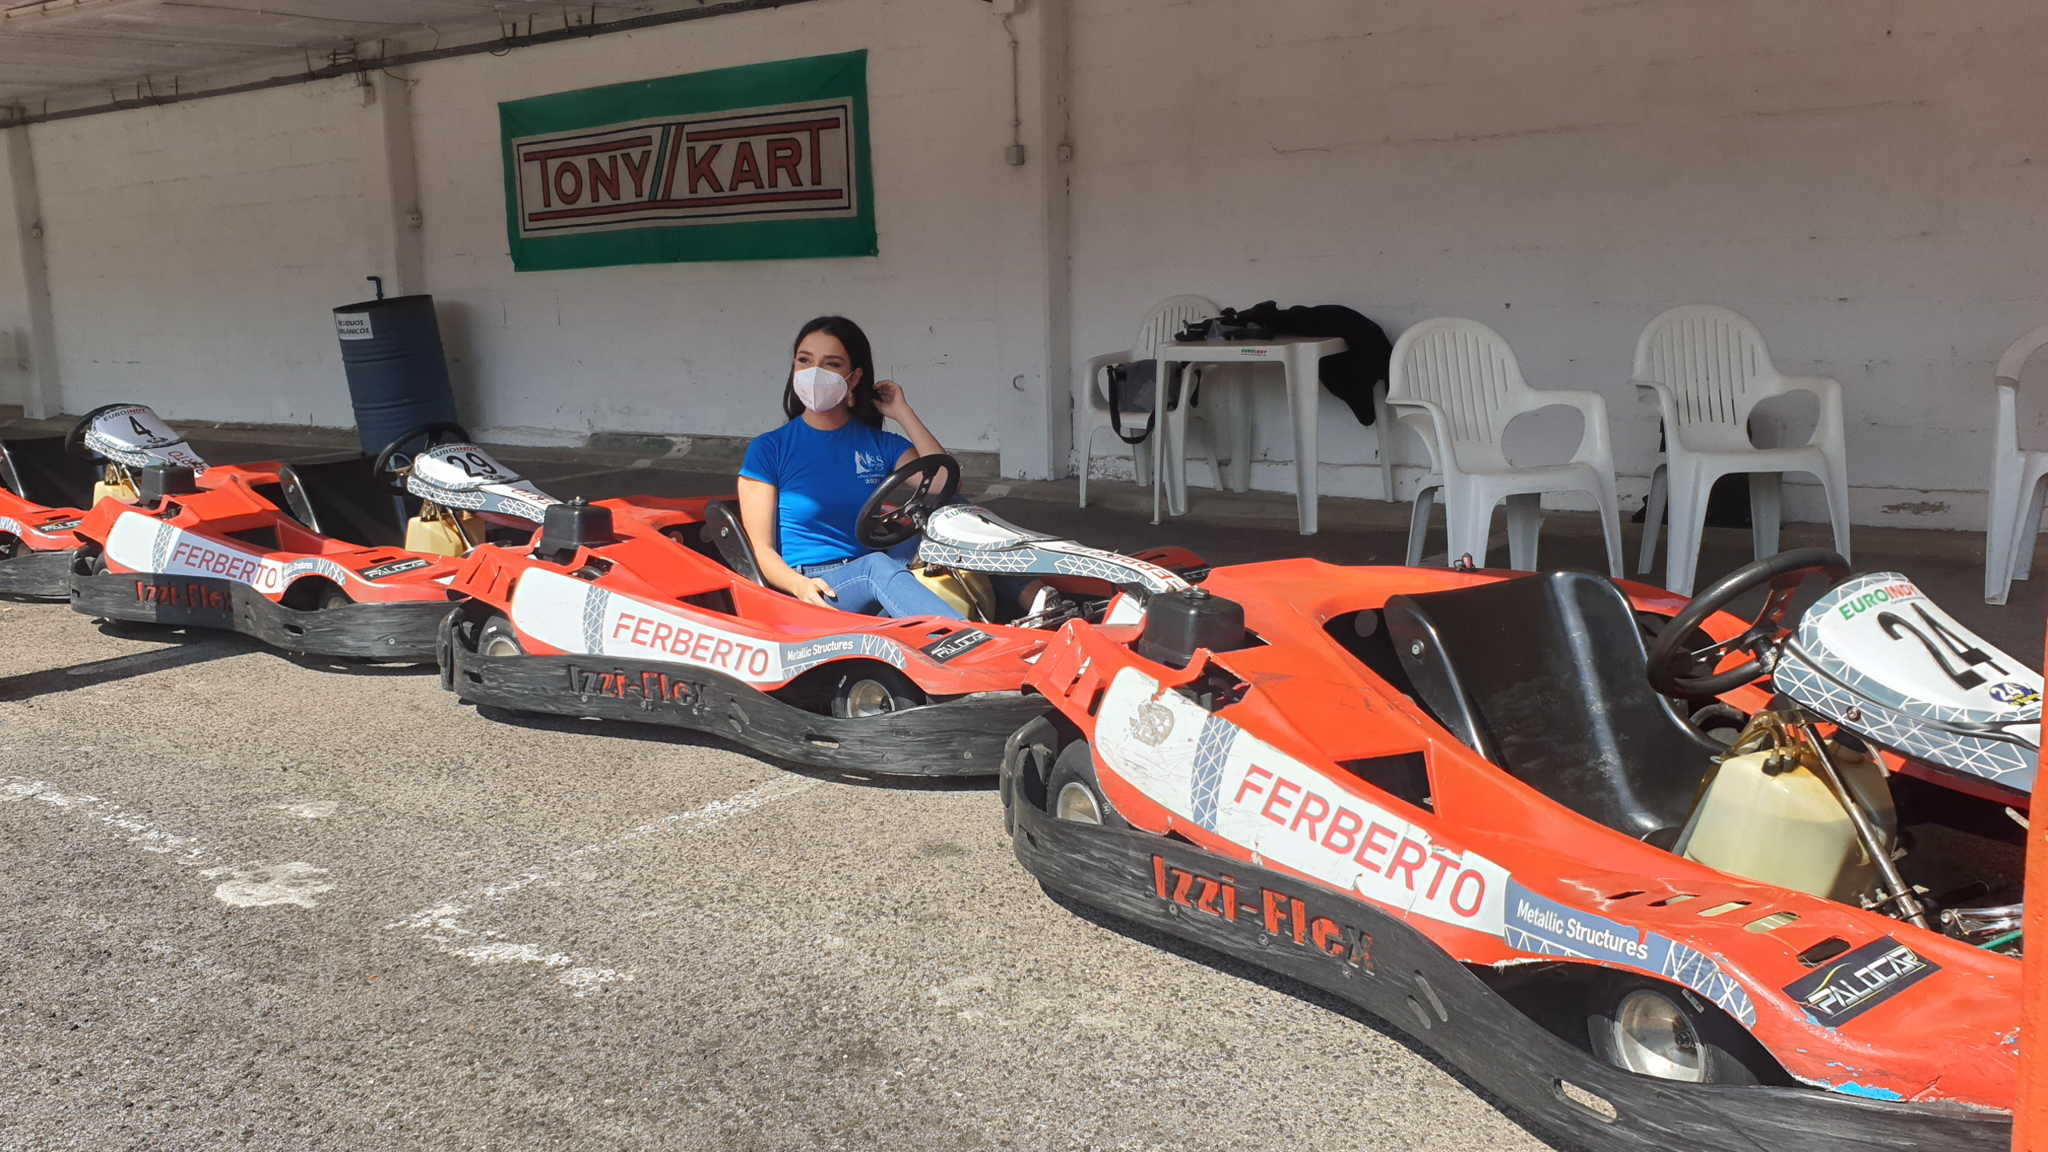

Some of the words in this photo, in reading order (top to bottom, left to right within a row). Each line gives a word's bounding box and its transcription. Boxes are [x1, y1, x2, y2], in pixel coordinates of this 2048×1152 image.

[523, 135, 652, 208] TONY
[686, 117, 841, 195] KART
[103, 408, 147, 422] EUROINDY
[129, 415, 155, 438] 4
[429, 446, 478, 459] EUROINDY
[446, 452, 498, 478] 29
[172, 542, 278, 588] FERBERTO
[363, 559, 429, 578] PALOCAR
[135, 580, 234, 612] Izzi-Flex
[1838, 584, 1918, 621] EUROINDY
[612, 612, 770, 677] FERBERTO
[787, 647, 812, 662] Metallic
[812, 640, 854, 656] Structures
[931, 629, 990, 658] PALOCAR
[1877, 602, 2010, 691] 24
[568, 663, 712, 711] Izzi-Flex
[1233, 763, 1486, 918] FERBERTO
[1152, 854, 1376, 977] Izzi-Flex
[1517, 898, 1564, 935] Metallic
[1565, 918, 1649, 961] Structures
[1806, 945, 1928, 1017] PALOCAR
